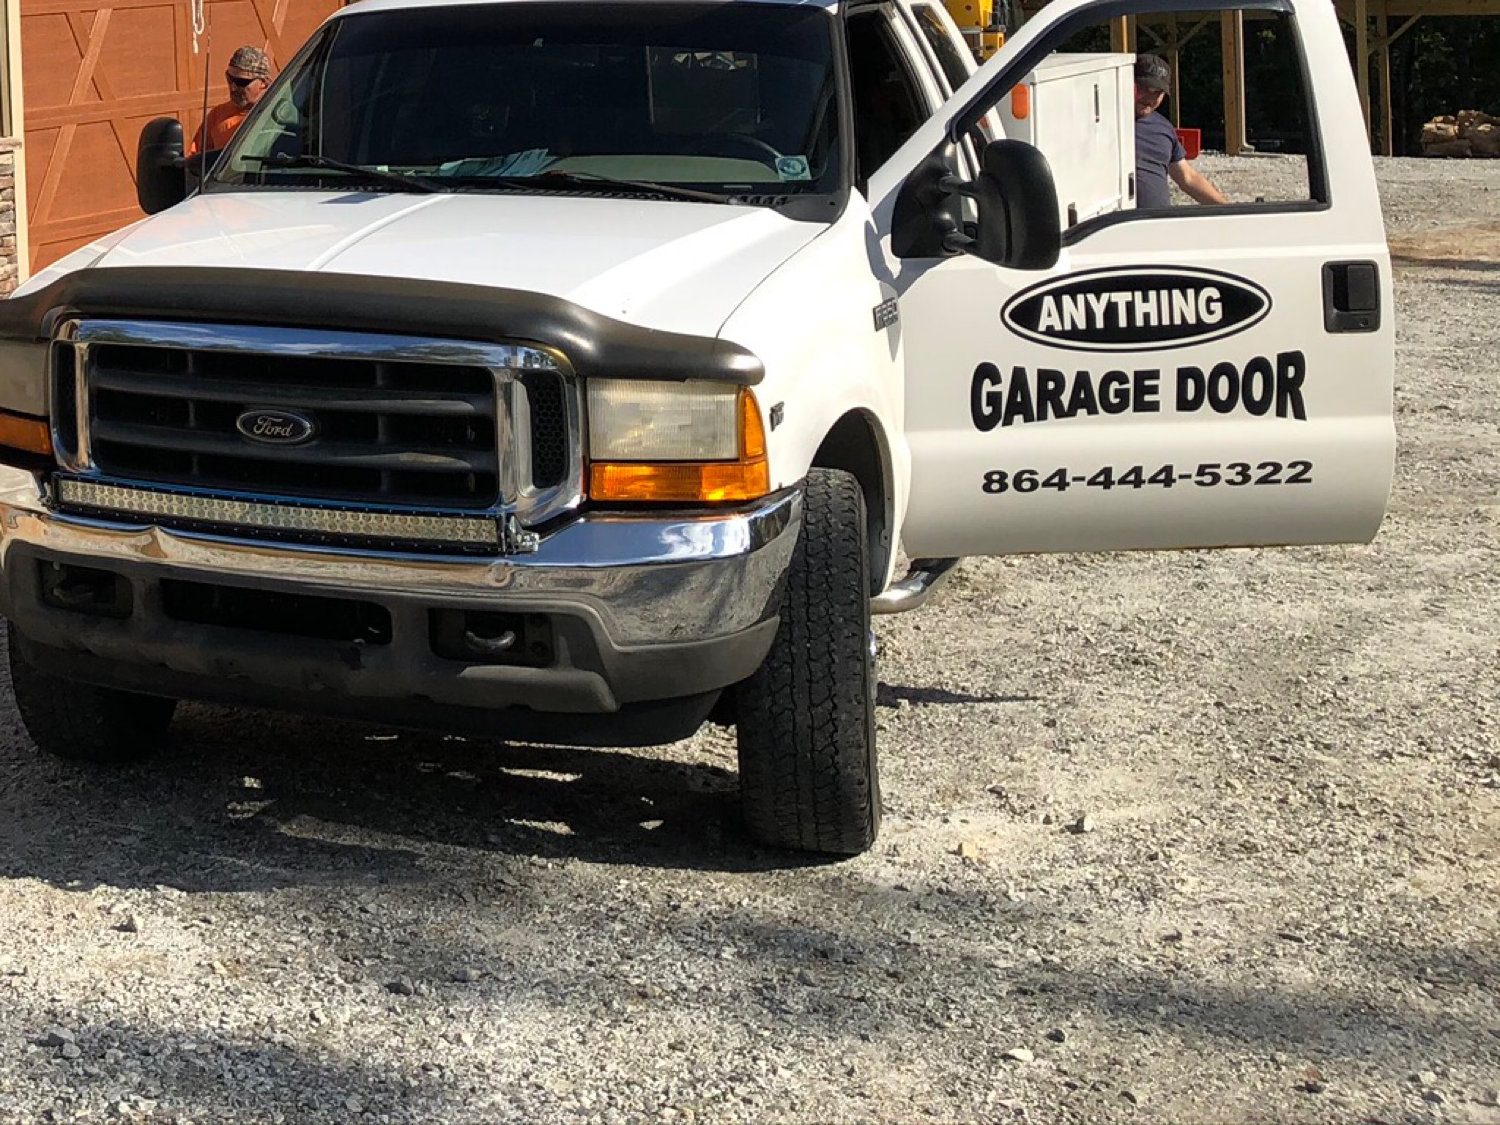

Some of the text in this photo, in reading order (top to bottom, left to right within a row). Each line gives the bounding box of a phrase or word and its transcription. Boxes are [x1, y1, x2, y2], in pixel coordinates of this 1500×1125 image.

[1038, 287, 1223, 332] ANYTHING
[971, 350, 1307, 432] GARAGE DOOR
[253, 416, 293, 436] Ford
[982, 461, 1313, 494] 864-444-5322
